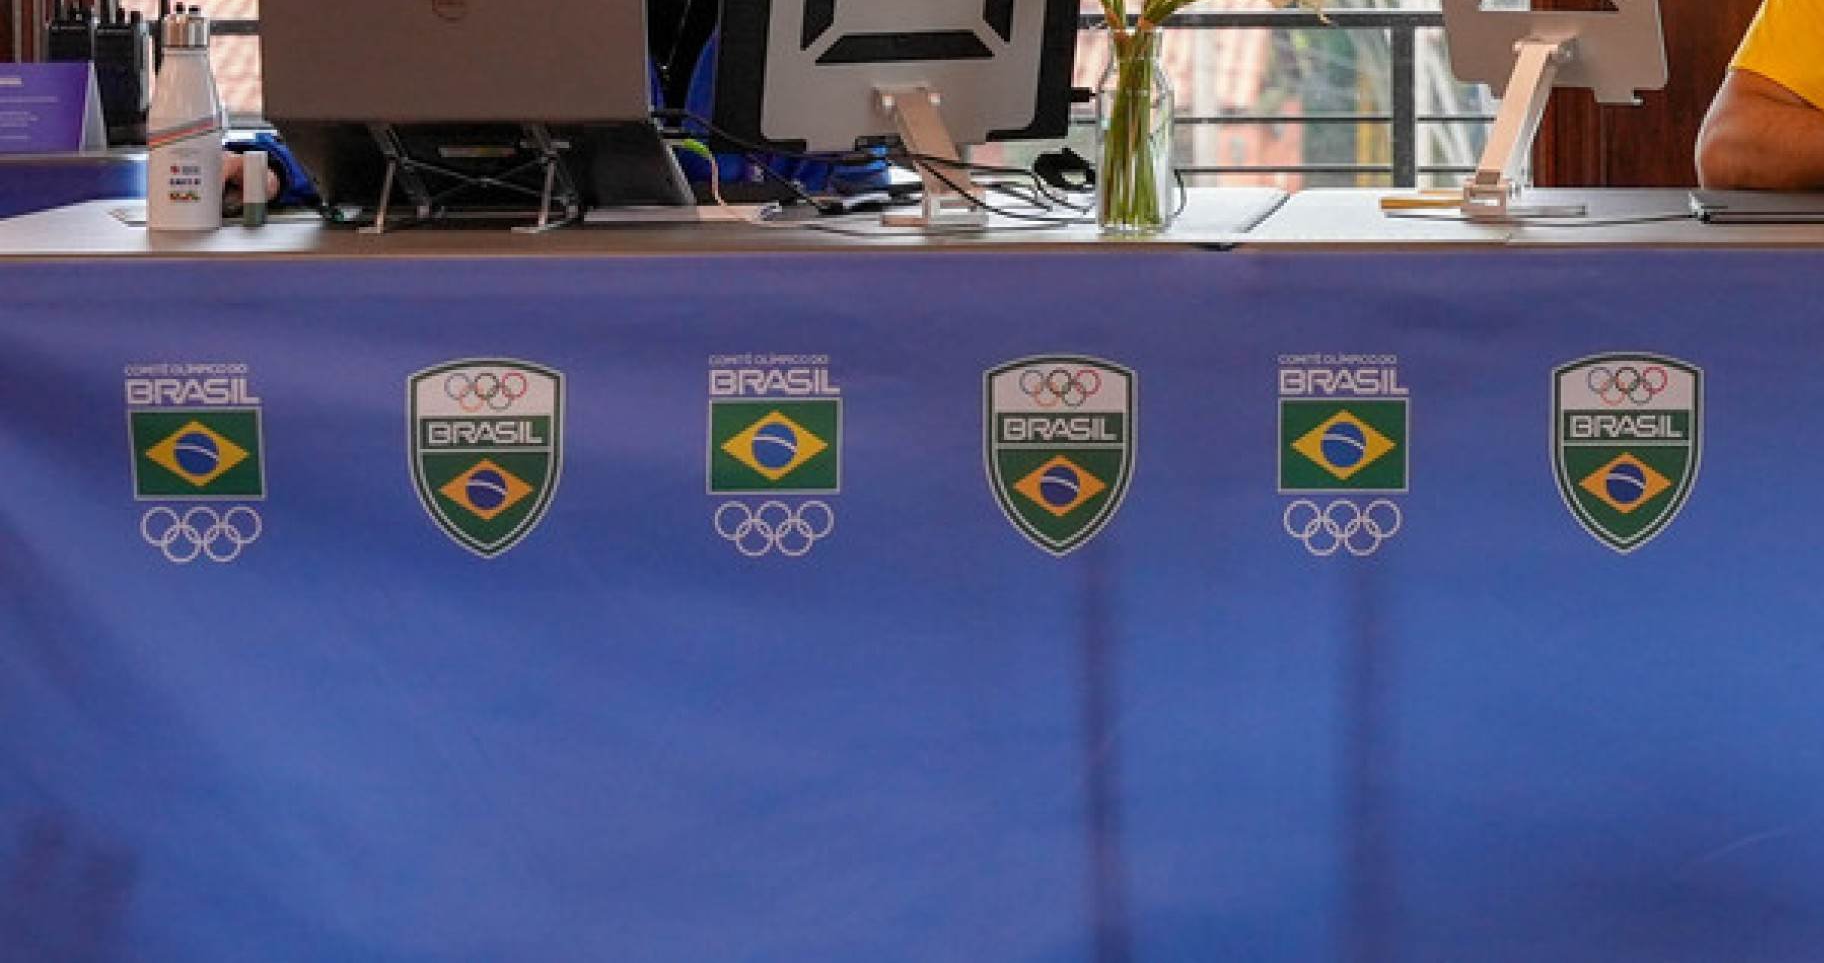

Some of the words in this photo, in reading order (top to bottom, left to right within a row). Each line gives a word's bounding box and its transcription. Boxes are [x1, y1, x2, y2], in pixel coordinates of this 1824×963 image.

[127, 378, 261, 404] BRASIL
[709, 369, 841, 395] BRASIL
[1279, 369, 1410, 395] BRASIL
[428, 421, 543, 444] BRASIL
[1003, 418, 1118, 440] BRASIL
[1569, 415, 1683, 438] BRASIL
